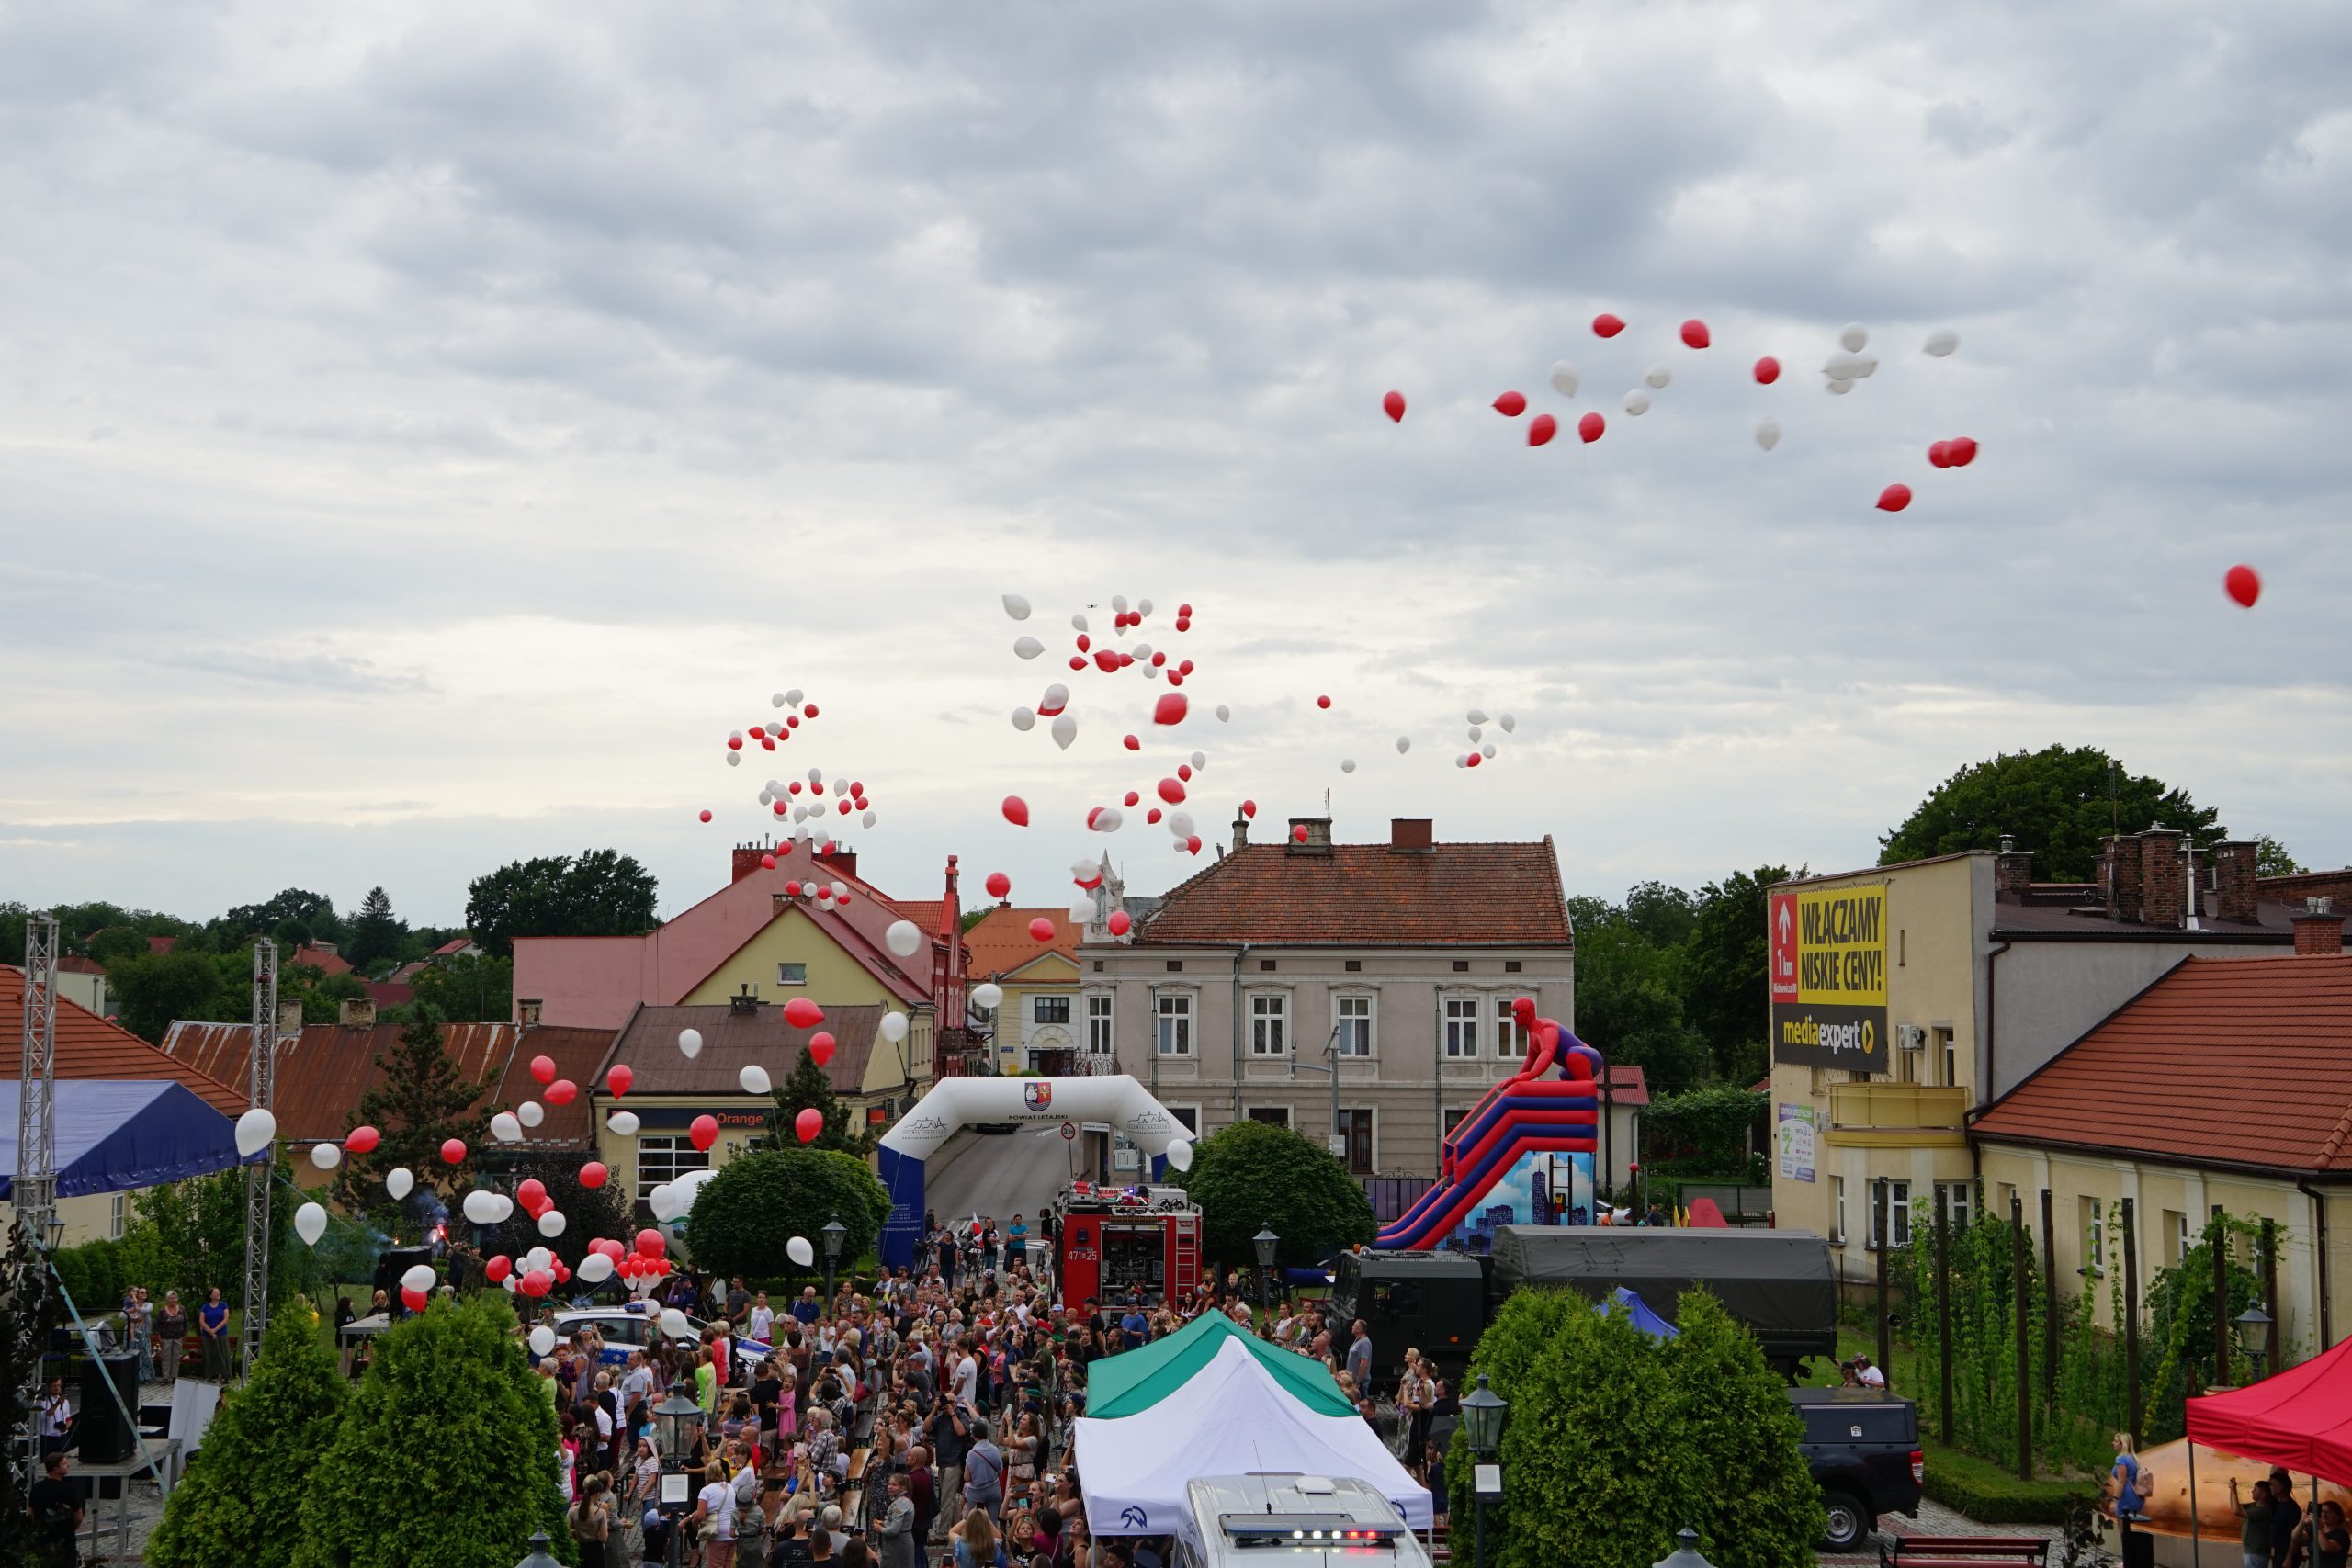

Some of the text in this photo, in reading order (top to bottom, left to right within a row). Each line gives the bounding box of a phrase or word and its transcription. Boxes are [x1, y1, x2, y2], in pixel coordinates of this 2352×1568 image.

[1801, 896, 1882, 948] WŁĄCZAMY
[1777, 948, 1793, 976] 1 km
[1801, 950, 1882, 992] NISKIE CENY!
[1783, 1014, 1860, 1055] mediaexpert
[717, 1112, 763, 1126] Orange
